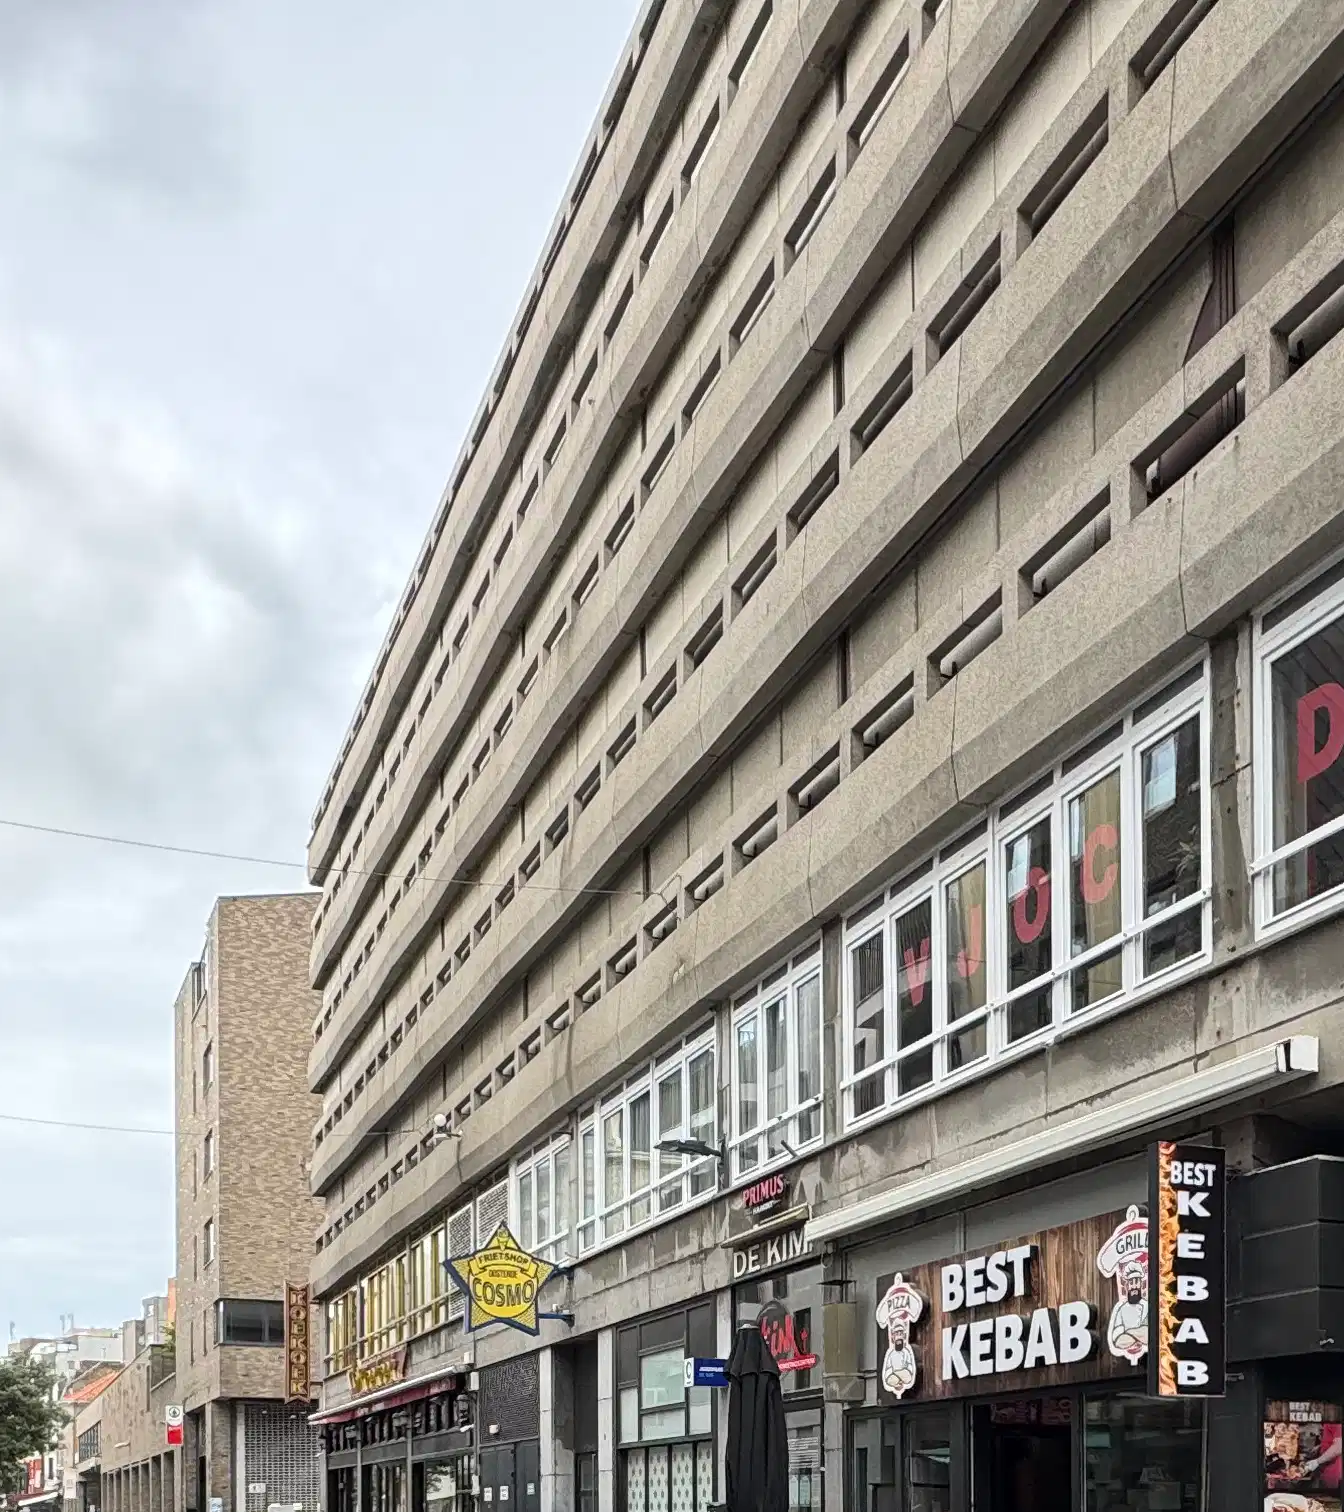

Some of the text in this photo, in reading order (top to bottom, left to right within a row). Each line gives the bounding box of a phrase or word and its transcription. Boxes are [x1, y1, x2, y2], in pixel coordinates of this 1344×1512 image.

[1170, 1160, 1216, 1187] BEST
[742, 1174, 784, 1209] PRIMUS
[478, 1252, 529, 1266] FRIETSHOP
[733, 1225, 809, 1279] DE KIM
[472, 1278, 534, 1307] COSMO
[941, 1245, 1032, 1313] BEST
[1175, 1190, 1212, 1387] KEBAB
[887, 1295, 911, 1309] PIZZA
[290, 1290, 307, 1396] KOEKOEK
[942, 1301, 1093, 1381] KEBAB
[1289, 1402, 1310, 1411] BEST
[1289, 1412, 1322, 1422] KEBAB
